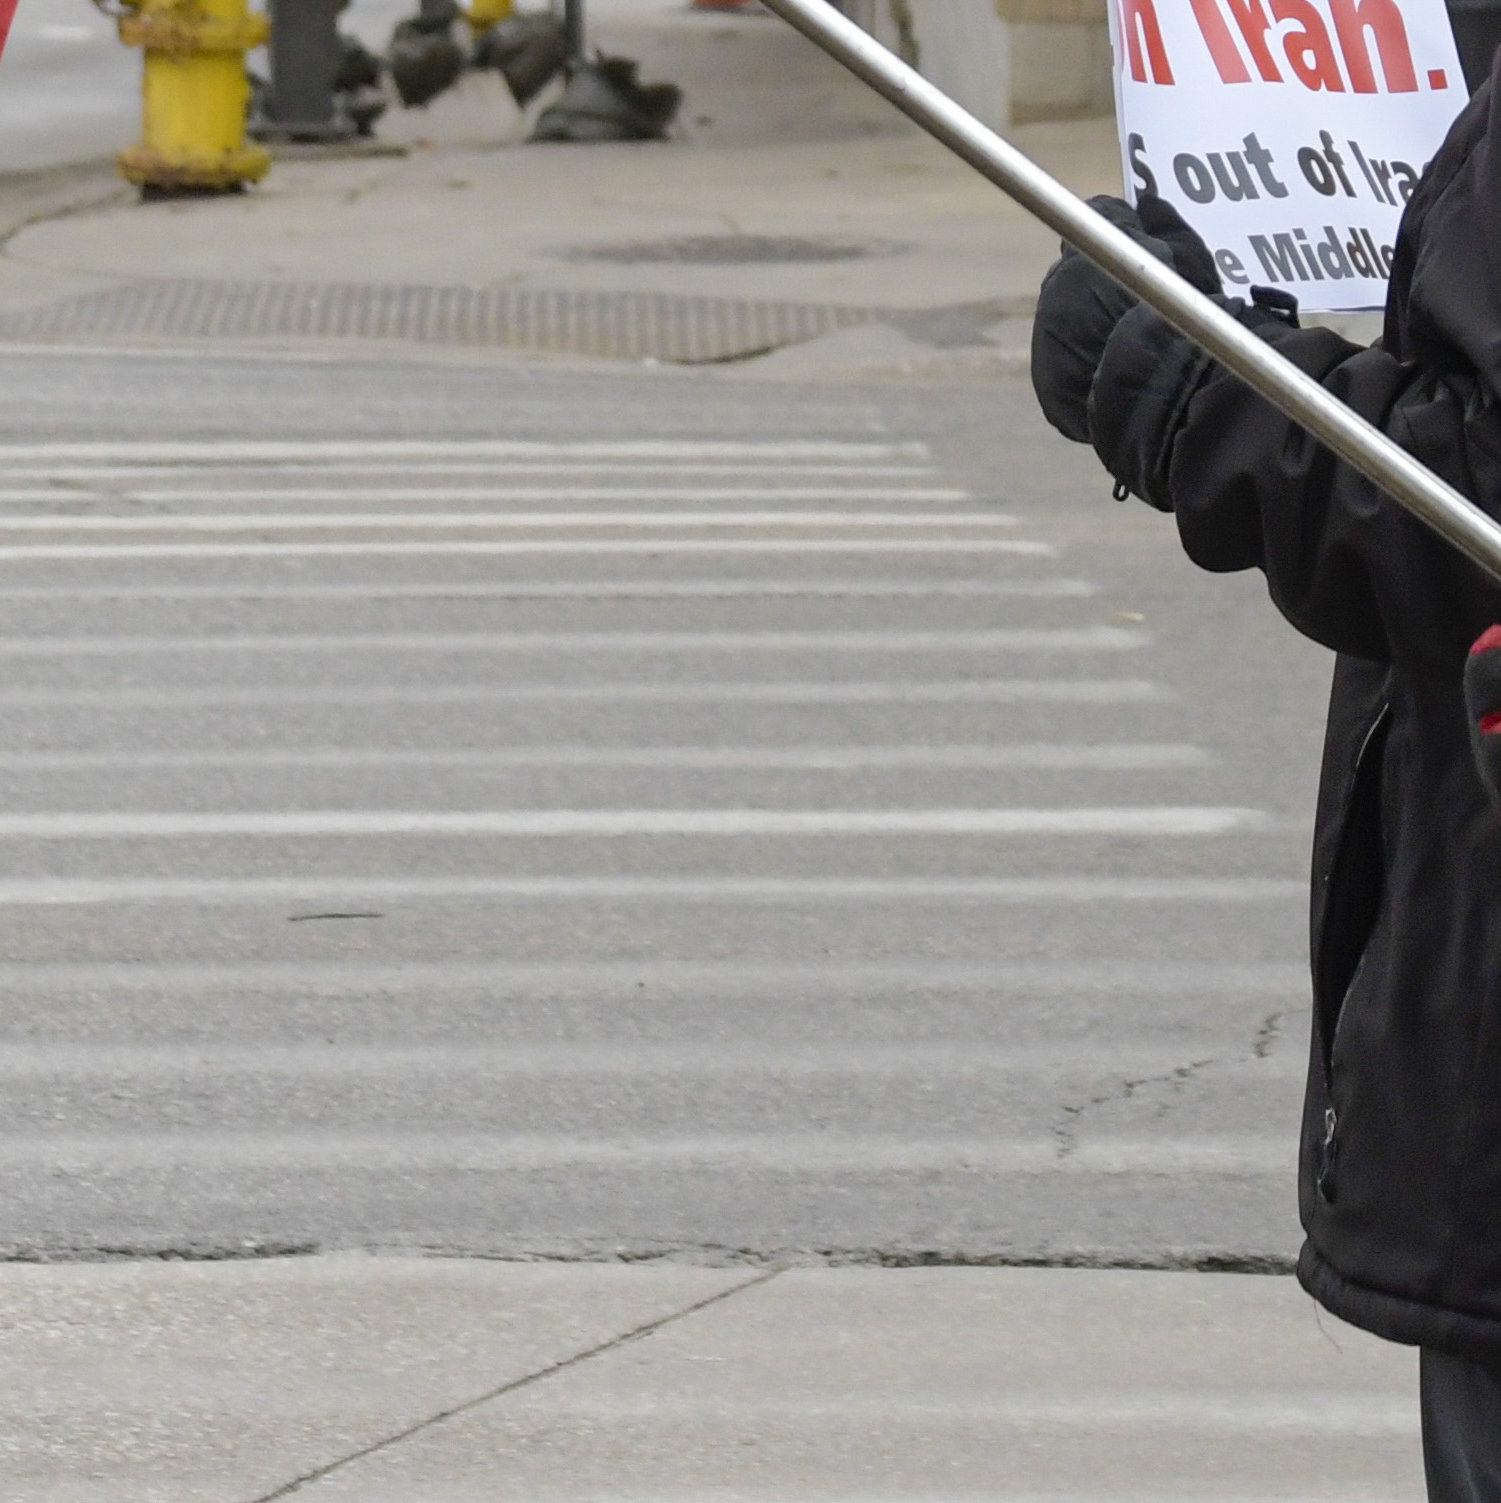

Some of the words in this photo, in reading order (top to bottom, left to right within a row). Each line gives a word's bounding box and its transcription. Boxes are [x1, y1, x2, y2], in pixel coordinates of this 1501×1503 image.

[1172, 131, 1290, 205] out
[1297, 129, 1358, 198] of
[1346, 139, 1431, 207] Ira
